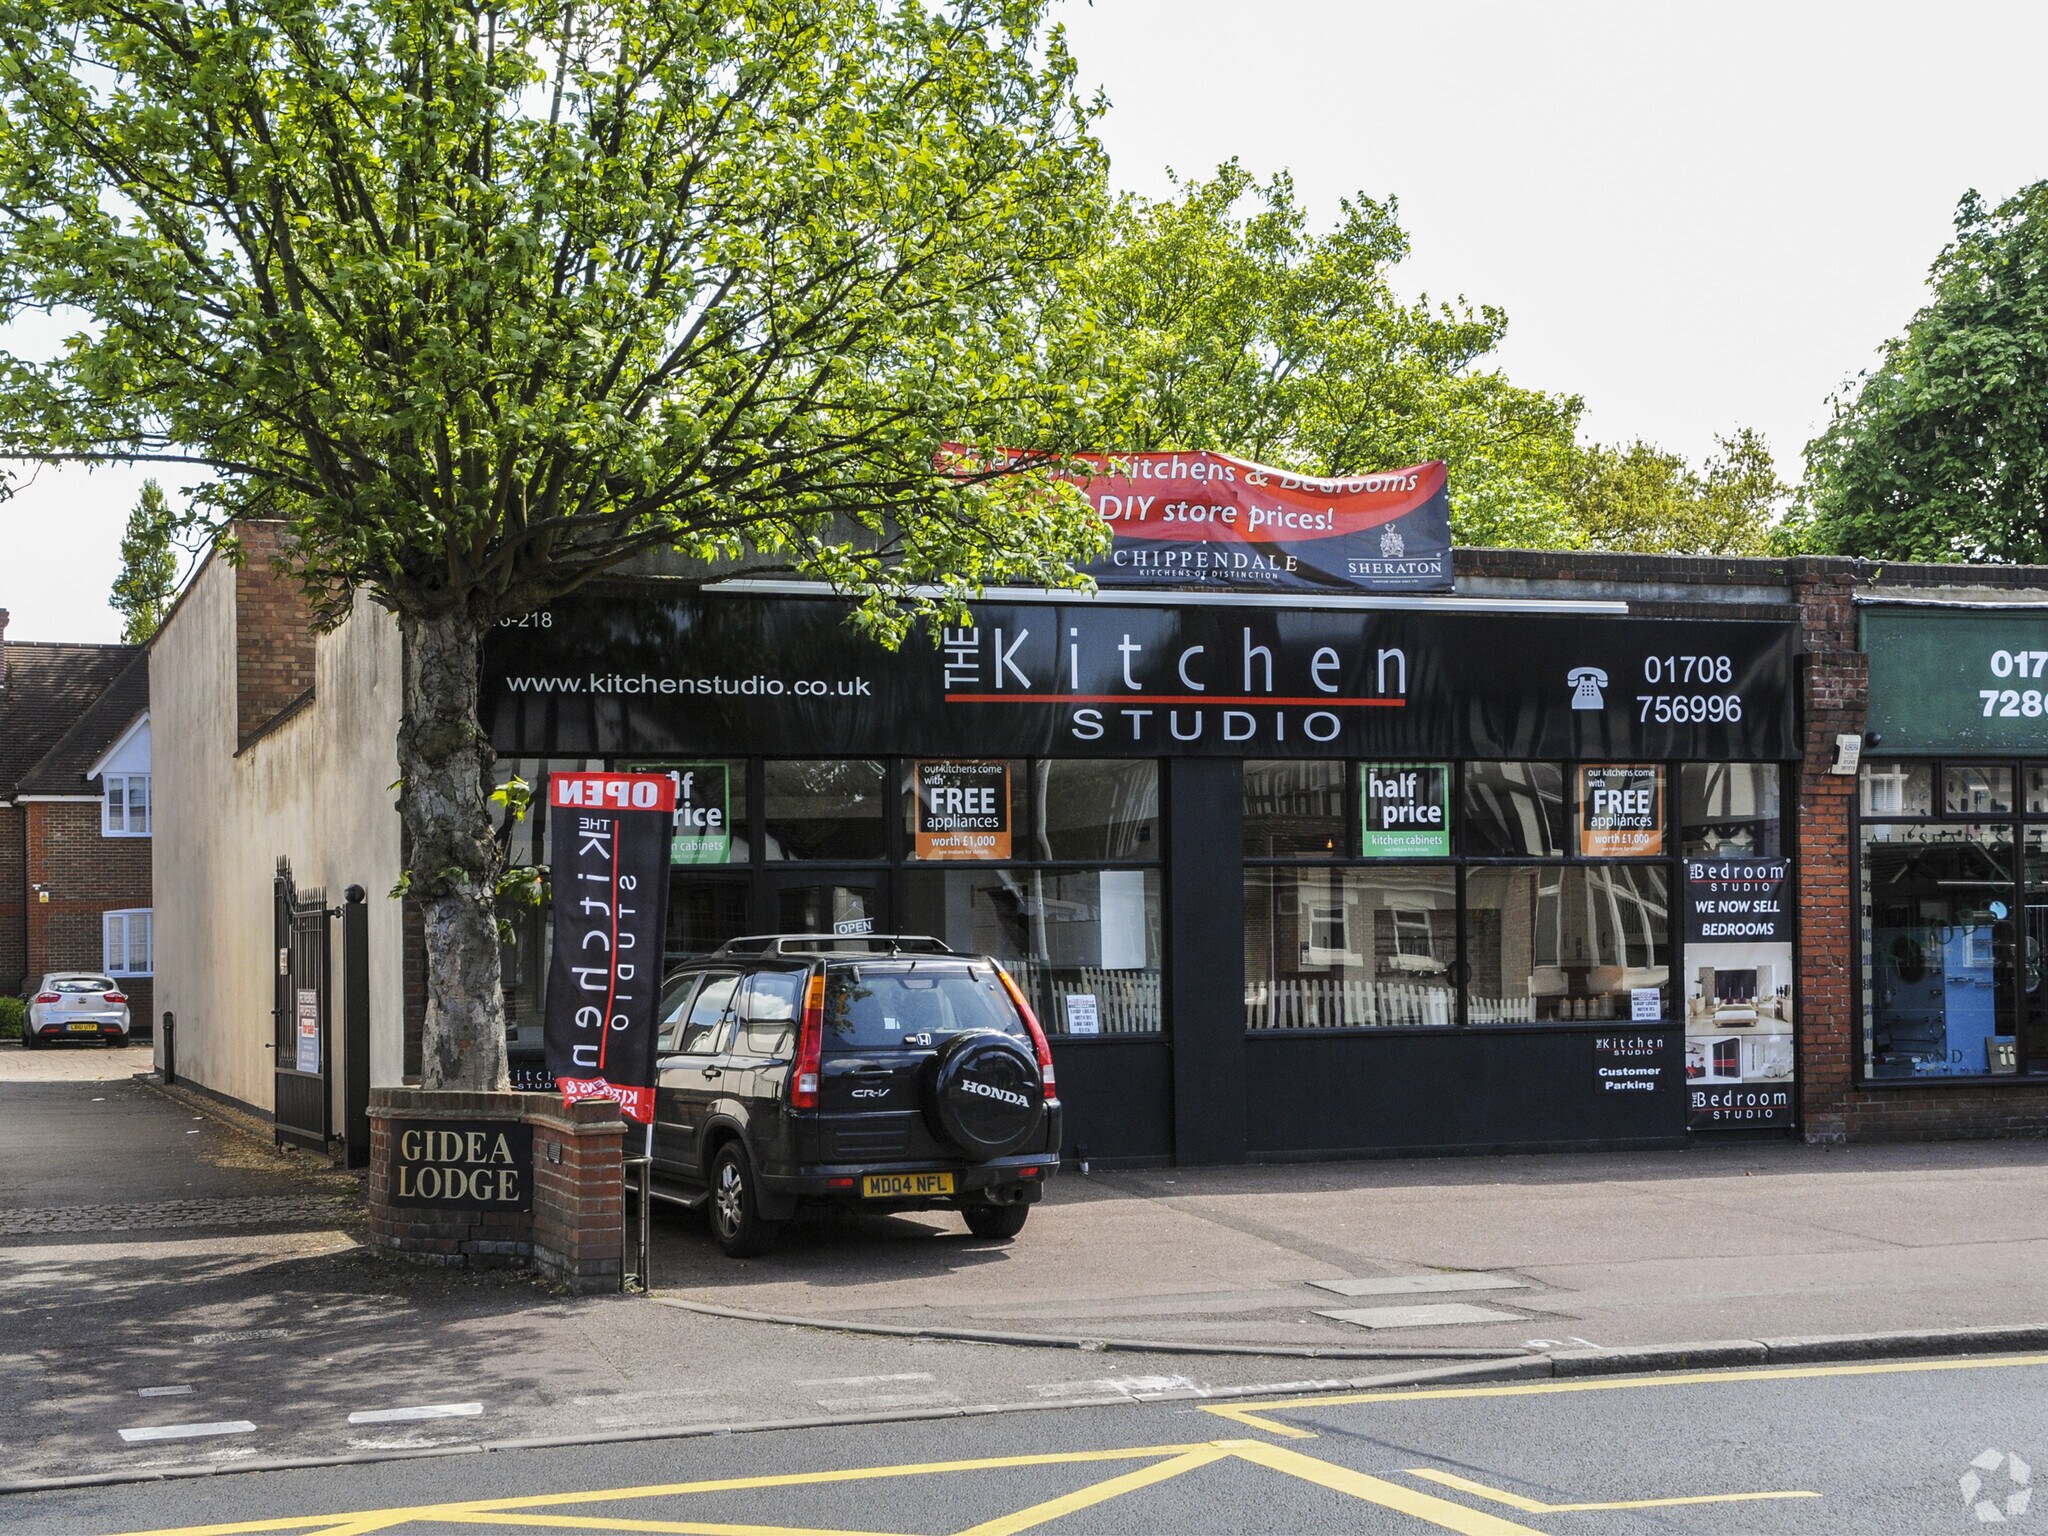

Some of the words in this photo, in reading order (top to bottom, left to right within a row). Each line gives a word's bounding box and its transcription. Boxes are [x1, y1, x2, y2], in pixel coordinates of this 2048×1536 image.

[1100, 495, 1157, 521] DIY
[1163, 502, 1238, 524] store
[1248, 506, 1334, 532] prices!
[1114, 550, 1298, 572] CHIPPENDALE
[1348, 562, 1442, 574] SHERATON
[1140, 569, 1190, 577] KITCHENS
[1195, 570, 1207, 578] OF
[1212, 570, 1278, 579] DISTINCTION
[944, 628, 979, 689] THE
[994, 627, 1406, 694] Kitchen
[1644, 656, 1732, 683] 01708
[506, 673, 871, 697] www.kitchenstudio.co.uk
[1636, 695, 1742, 723] 756996
[1980, 690, 2048, 717] 728
[1072, 710, 1342, 742] STUDIO
[924, 766, 939, 774] our
[940, 764, 976, 774] kitchens
[978, 766, 1002, 774] come
[1603, 768, 1633, 777] kitchens
[924, 774, 943, 785] with
[1370, 773, 1417, 798] half
[1588, 779, 1605, 787] with
[930, 788, 996, 814] FREE
[1594, 790, 1649, 814] FREE
[673, 801, 722, 827] rice
[1384, 800, 1442, 829] price
[1591, 814, 1652, 830] appliances
[927, 814, 999, 831] appliances
[680, 840, 723, 851] cabinets
[931, 836, 960, 846] worth
[963, 836, 995, 847] £1,000
[1372, 835, 1404, 845] kitchen
[1406, 835, 1442, 845] cabinets
[1595, 834, 1620, 844] worth
[1622, 834, 1649, 844] £1,000
[1695, 863, 1784, 879] Bedroom
[1711, 883, 1770, 892] STUDIO
[1696, 901, 1715, 913] WE
[1718, 901, 1750, 913] NOW
[1753, 900, 1780, 913] SELL
[839, 920, 872, 934] OPEN
[1702, 923, 1774, 936] BEDROOMS
[1603, 1037, 1663, 1049] Kitchen
[1599, 1067, 1661, 1076] Customer
[852, 1089, 890, 1098] CR-V
[961, 1080, 1030, 1108] HONDA
[1606, 1081, 1654, 1091] Parking
[1697, 1090, 1786, 1107] Bedroom
[1714, 1109, 1773, 1119] STUDIO
[402, 1130, 514, 1164] GIDEA
[398, 1166, 519, 1201] LODGE
[870, 1176, 911, 1194] MD04
[916, 1175, 947, 1192] NFL
